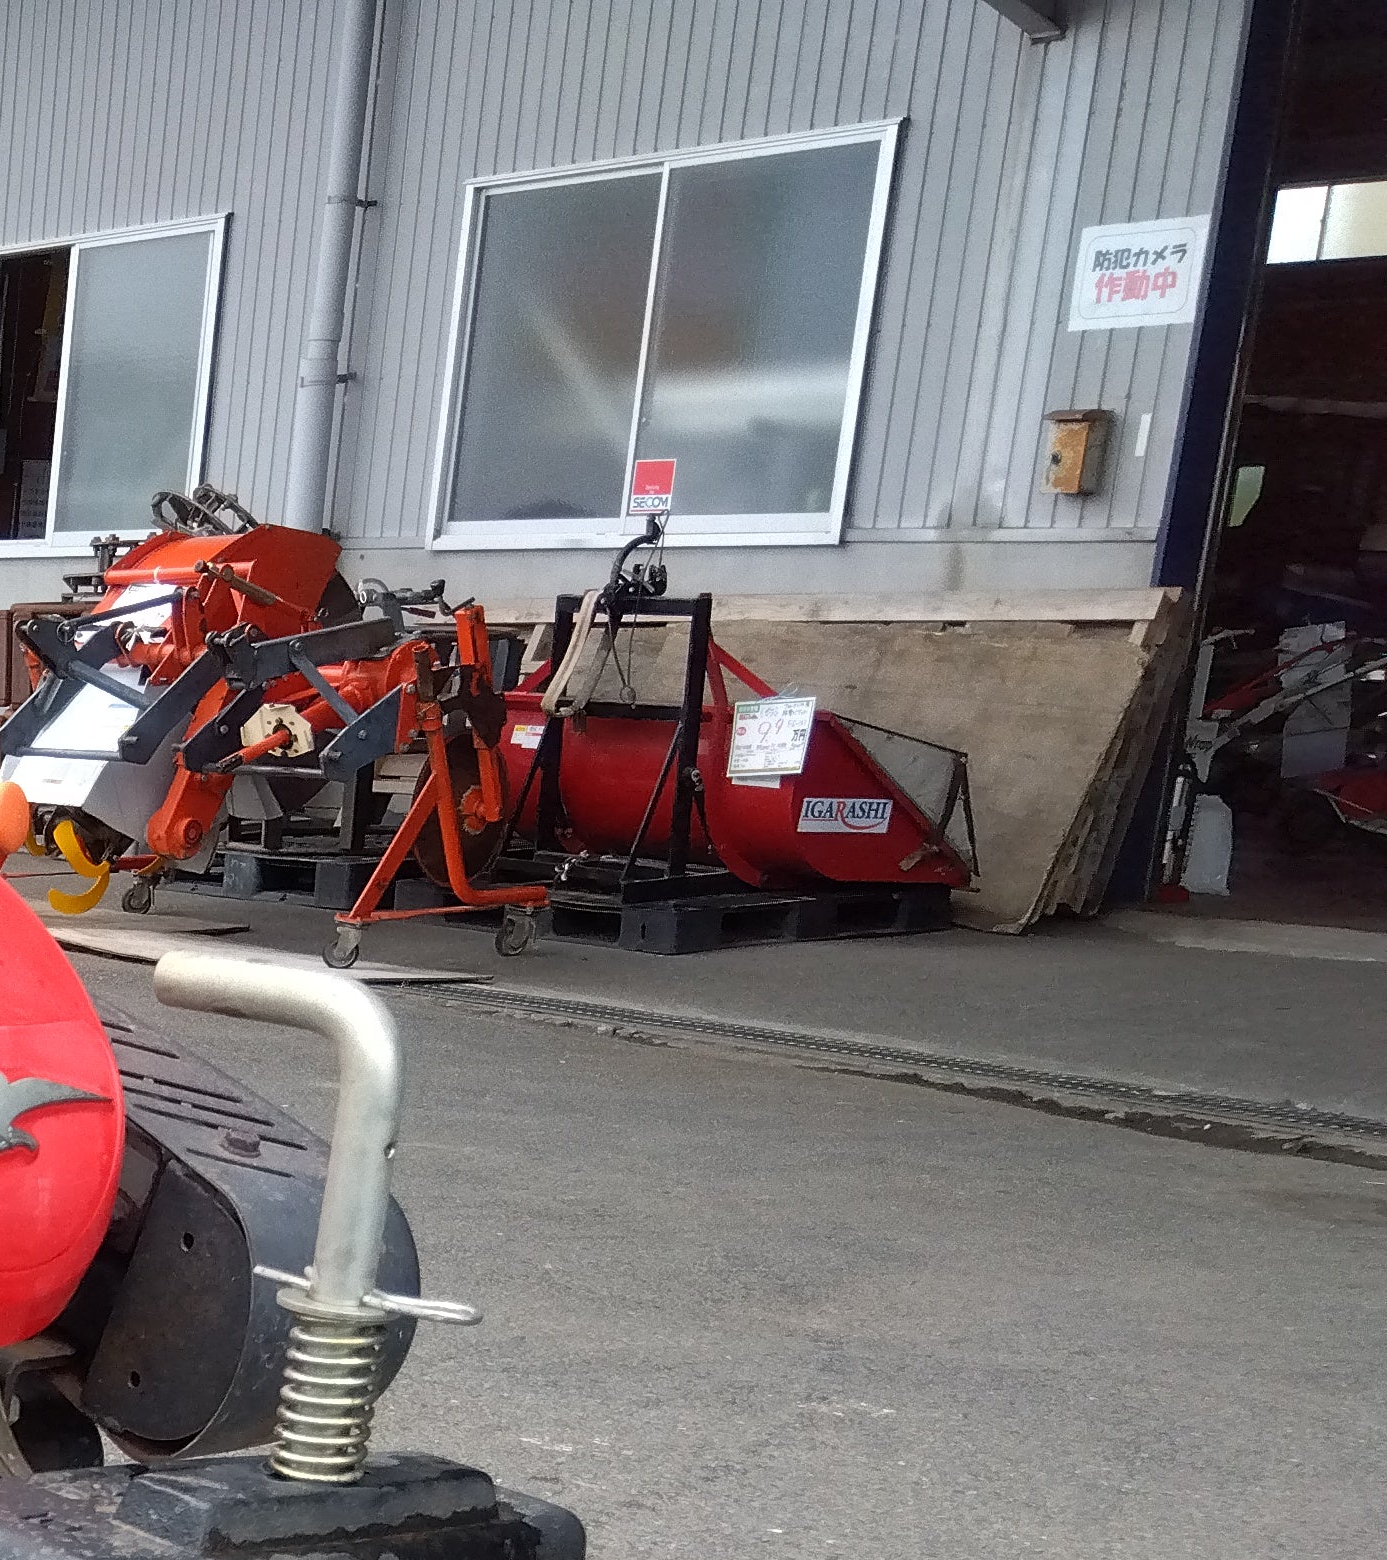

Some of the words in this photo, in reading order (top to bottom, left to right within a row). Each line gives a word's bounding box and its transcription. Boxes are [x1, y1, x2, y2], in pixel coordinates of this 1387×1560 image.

[1092, 242, 1188, 272] 防犯カメラ
[1095, 266, 1177, 304] 作動中
[633, 497, 668, 508] SECOM
[802, 799, 890, 821] IGARASHI
